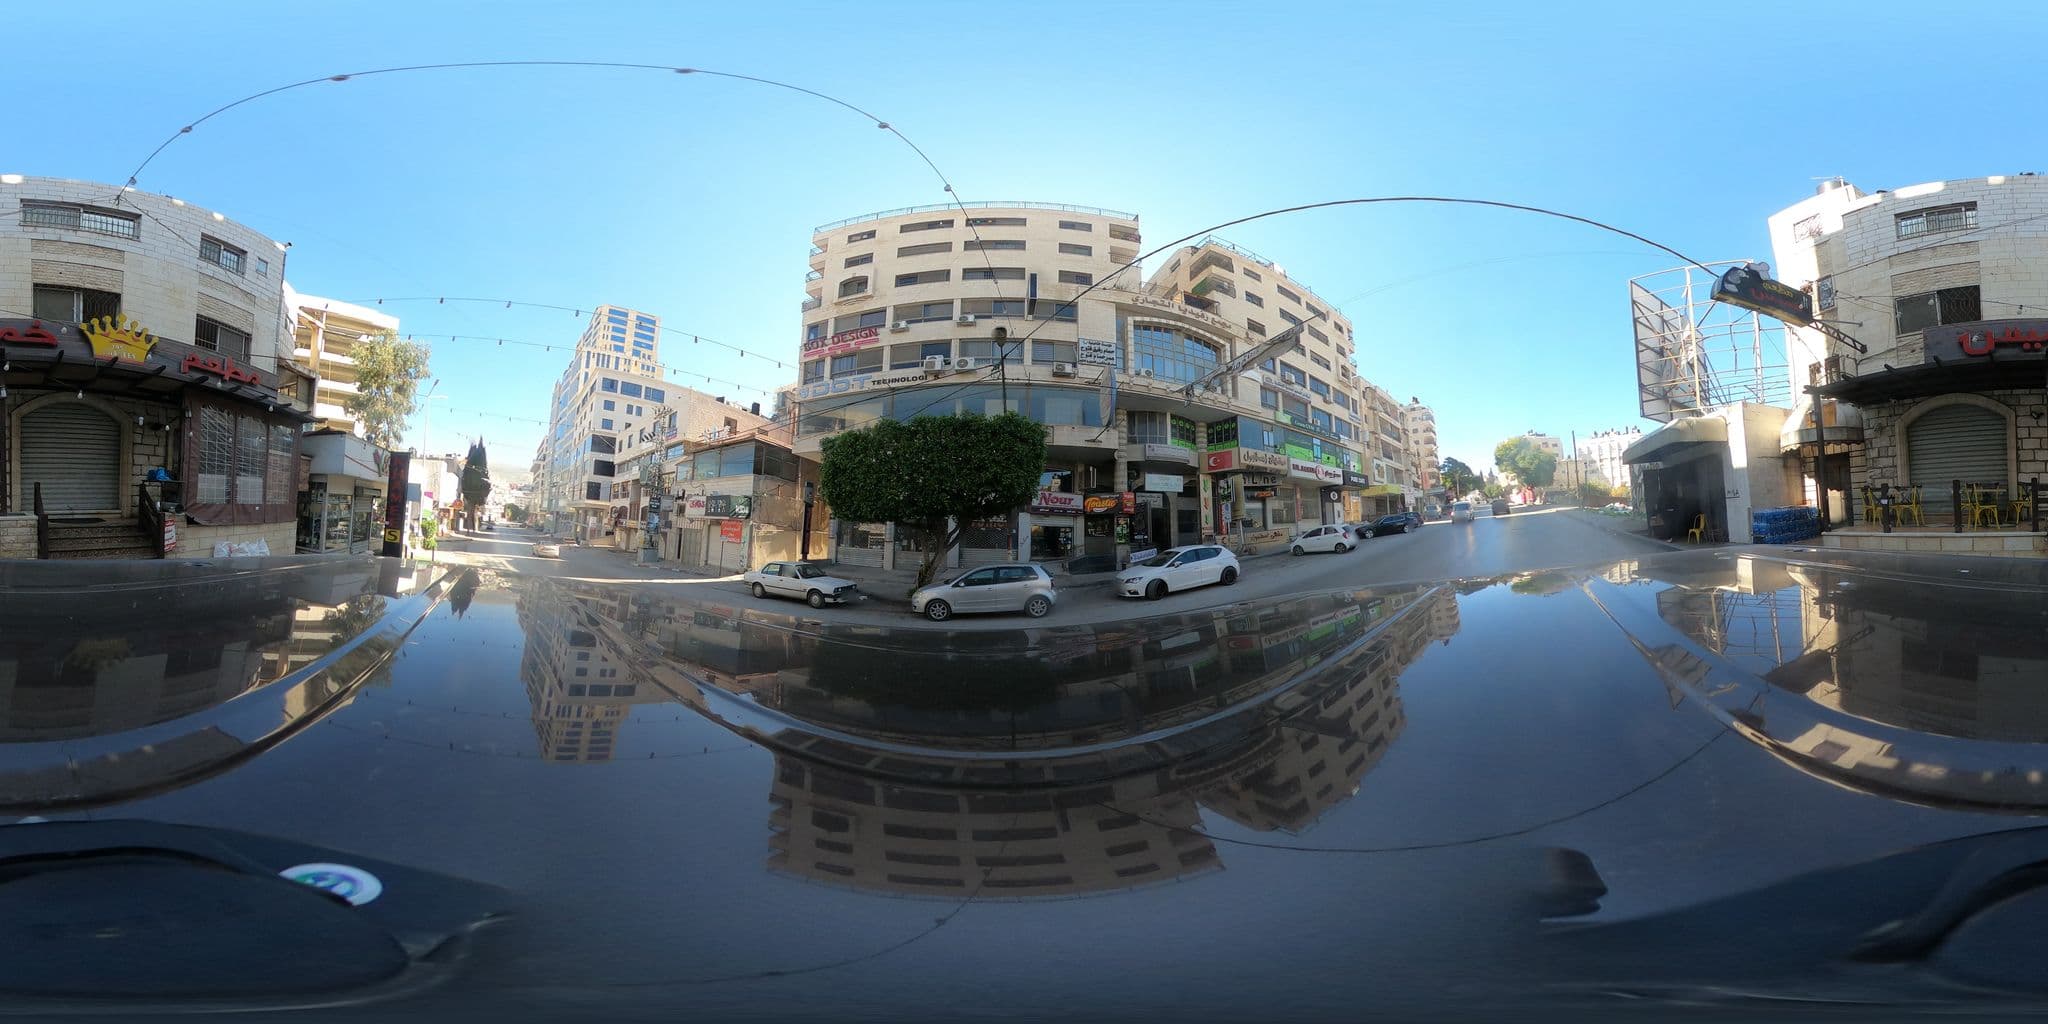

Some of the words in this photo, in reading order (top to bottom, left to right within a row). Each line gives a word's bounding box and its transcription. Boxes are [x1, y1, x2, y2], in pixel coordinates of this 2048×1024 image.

[1131, 295, 1174, 309] التجاري
[803, 338, 829, 352] BOX
[831, 327, 878, 346] DESIGN
[181, 352, 261, 385] مطعم
[1038, 491, 1074, 506] Nour
